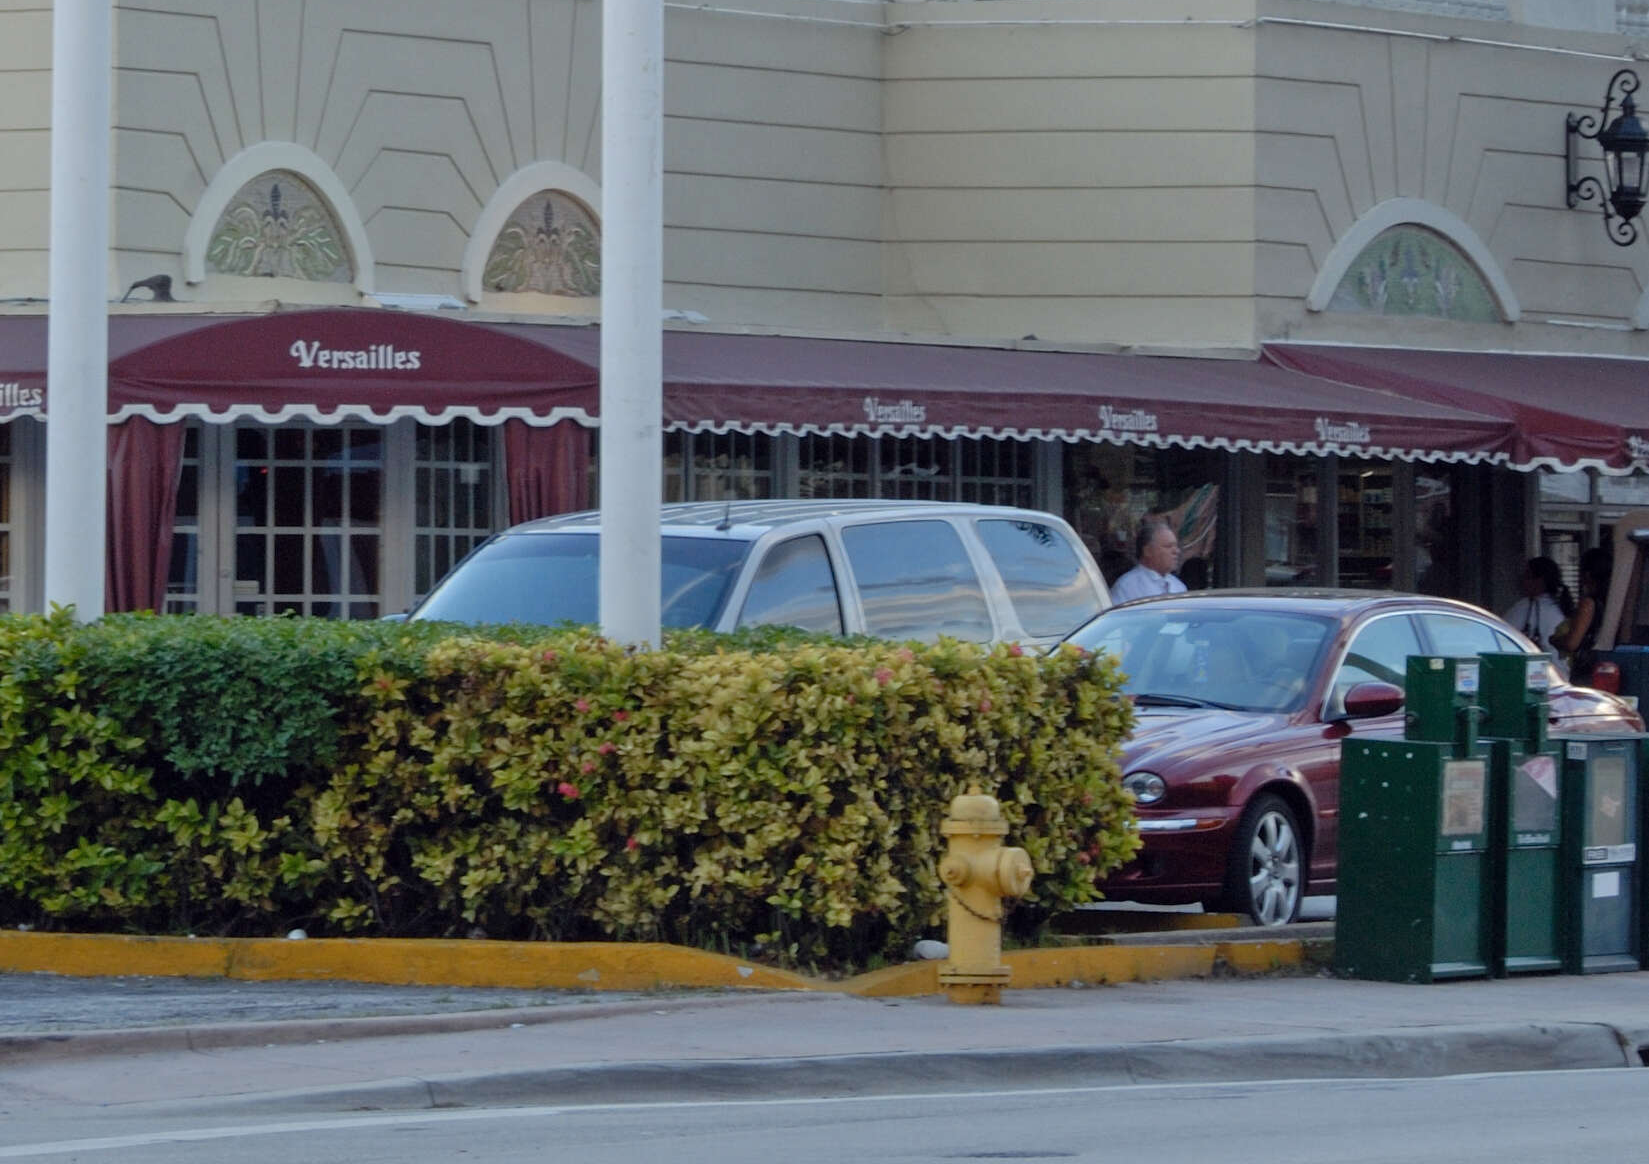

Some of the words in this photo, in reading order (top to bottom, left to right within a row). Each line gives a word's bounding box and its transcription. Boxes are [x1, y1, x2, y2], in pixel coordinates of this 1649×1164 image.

[289, 339, 421, 370] Versailles
[863, 396, 926, 423] Versailles
[1098, 404, 1158, 431] Versailles
